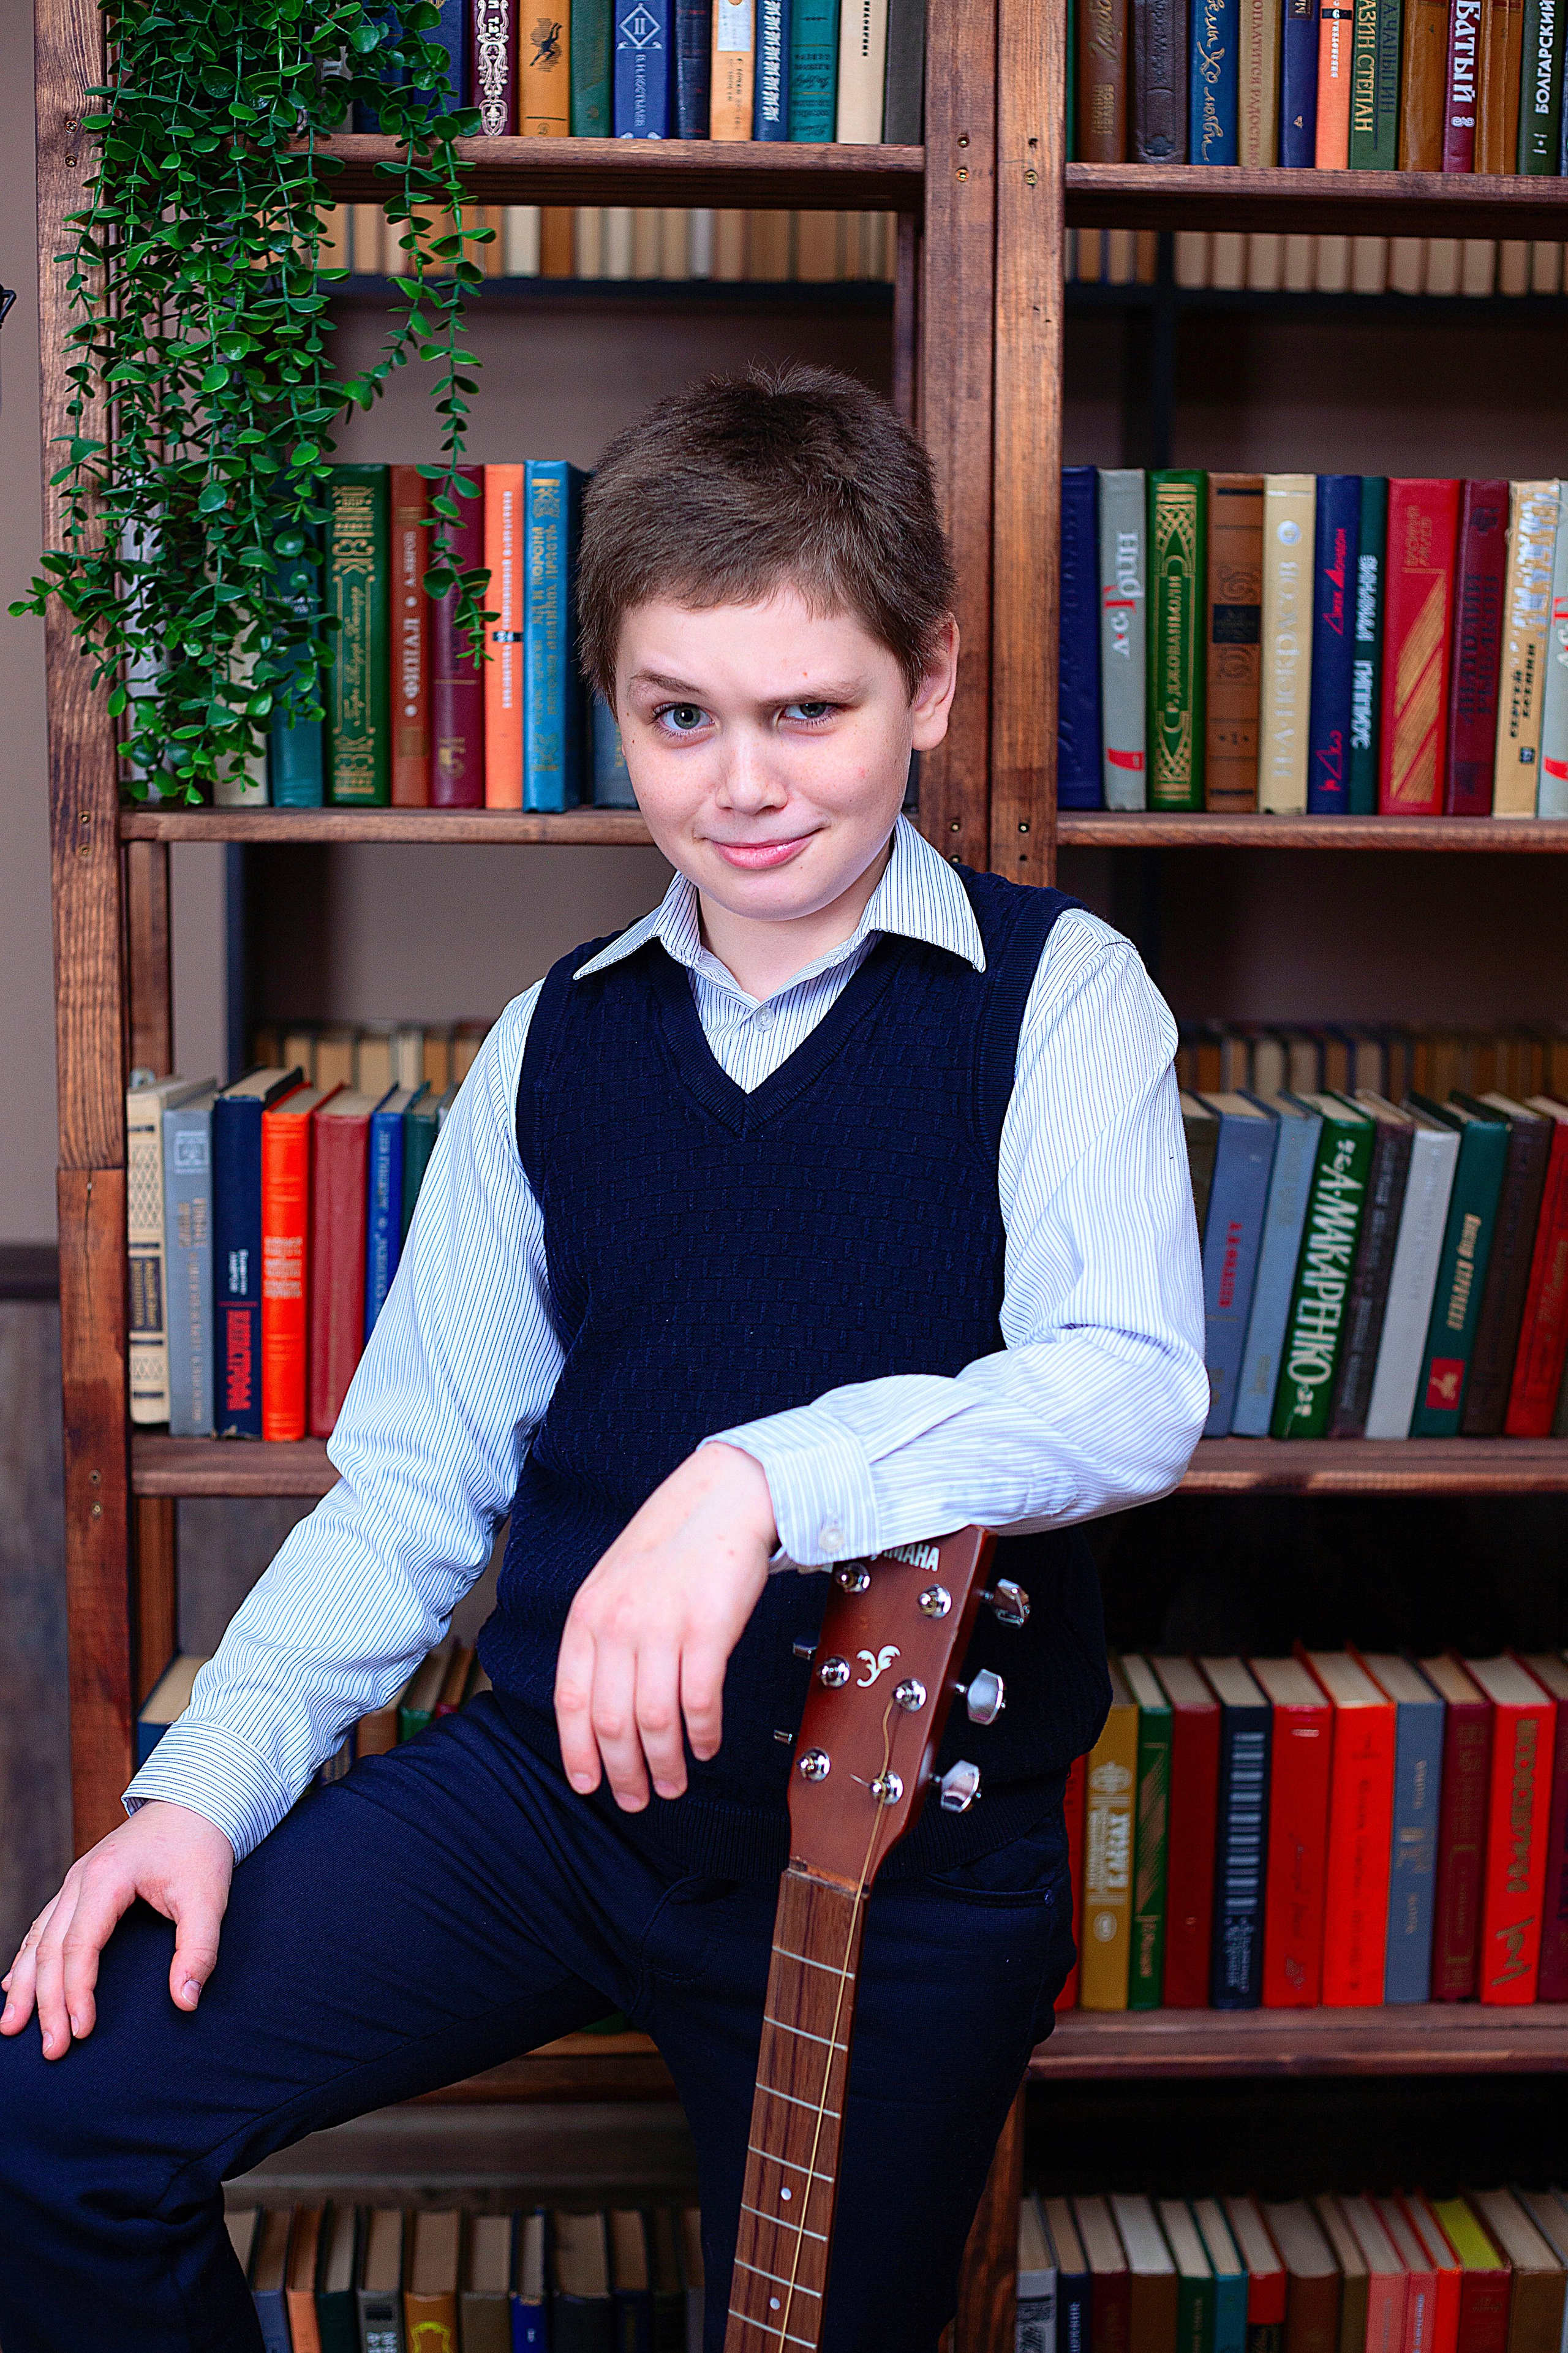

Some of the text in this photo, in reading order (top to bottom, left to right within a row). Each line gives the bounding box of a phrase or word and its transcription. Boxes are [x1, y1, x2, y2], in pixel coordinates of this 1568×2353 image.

[1354, 53, 1375, 133] СТЕПАН
[1452, 0, 1480, 103] БАТЫЙ
[1535, 0, 1555, 115] БОЛГАРСКИЙ
[870, 1543, 940, 1572] MAHA
